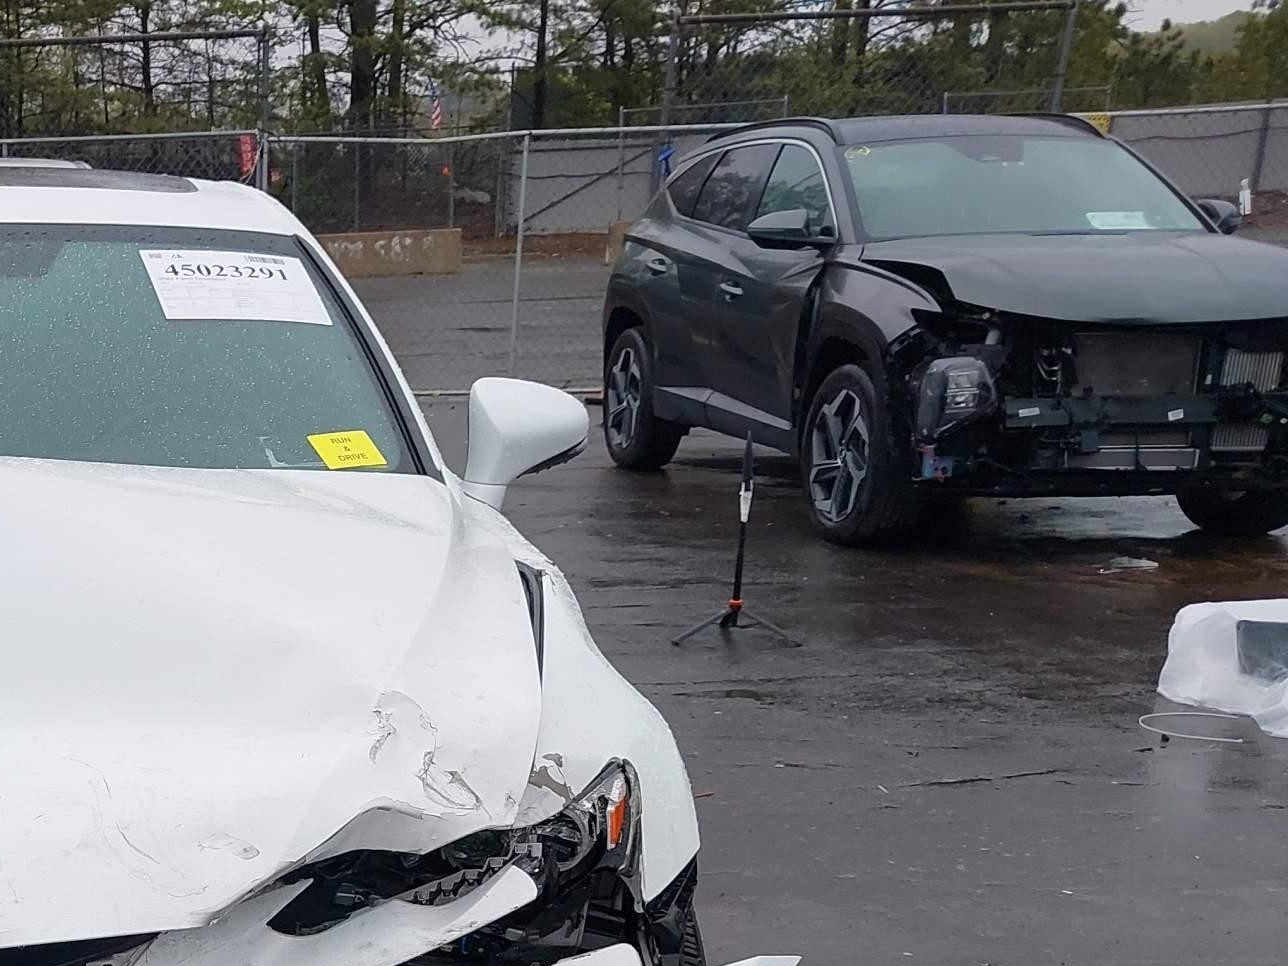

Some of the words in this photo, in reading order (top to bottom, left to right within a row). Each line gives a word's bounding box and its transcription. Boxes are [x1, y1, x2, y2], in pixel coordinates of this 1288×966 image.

[164, 263, 289, 281] 45023291
[329, 436, 353, 445] RUN
[337, 452, 369, 462] DRIVE
